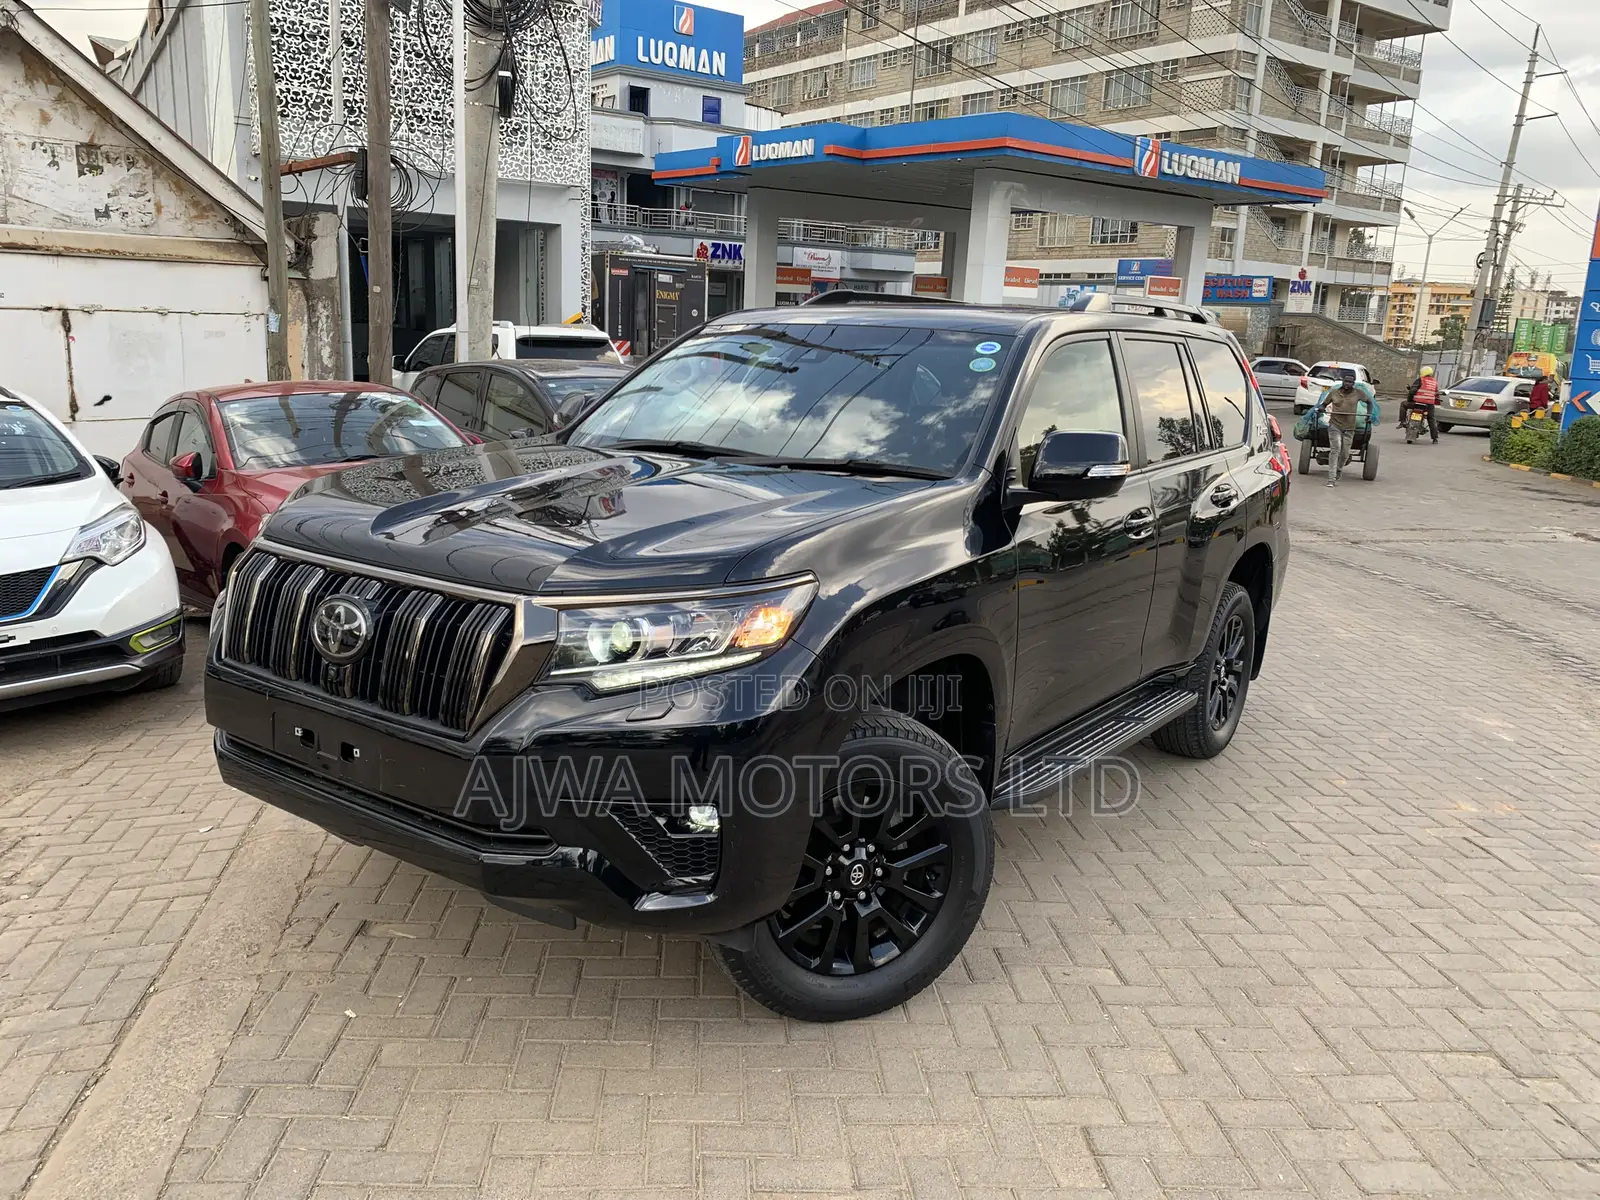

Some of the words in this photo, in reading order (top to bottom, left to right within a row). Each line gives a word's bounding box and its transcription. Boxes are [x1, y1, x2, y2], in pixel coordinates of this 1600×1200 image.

[590, 35, 615, 66] MAN
[637, 36, 726, 77] LUQMAN
[752, 138, 815, 161] LUQMAN
[1161, 150, 1240, 185] LUQMAN
[710, 241, 744, 261] ZNK
[1204, 277, 1252, 288] ECUTIVE
[1290, 280, 1312, 293] ZNK
[1216, 289, 1249, 299] WASH
